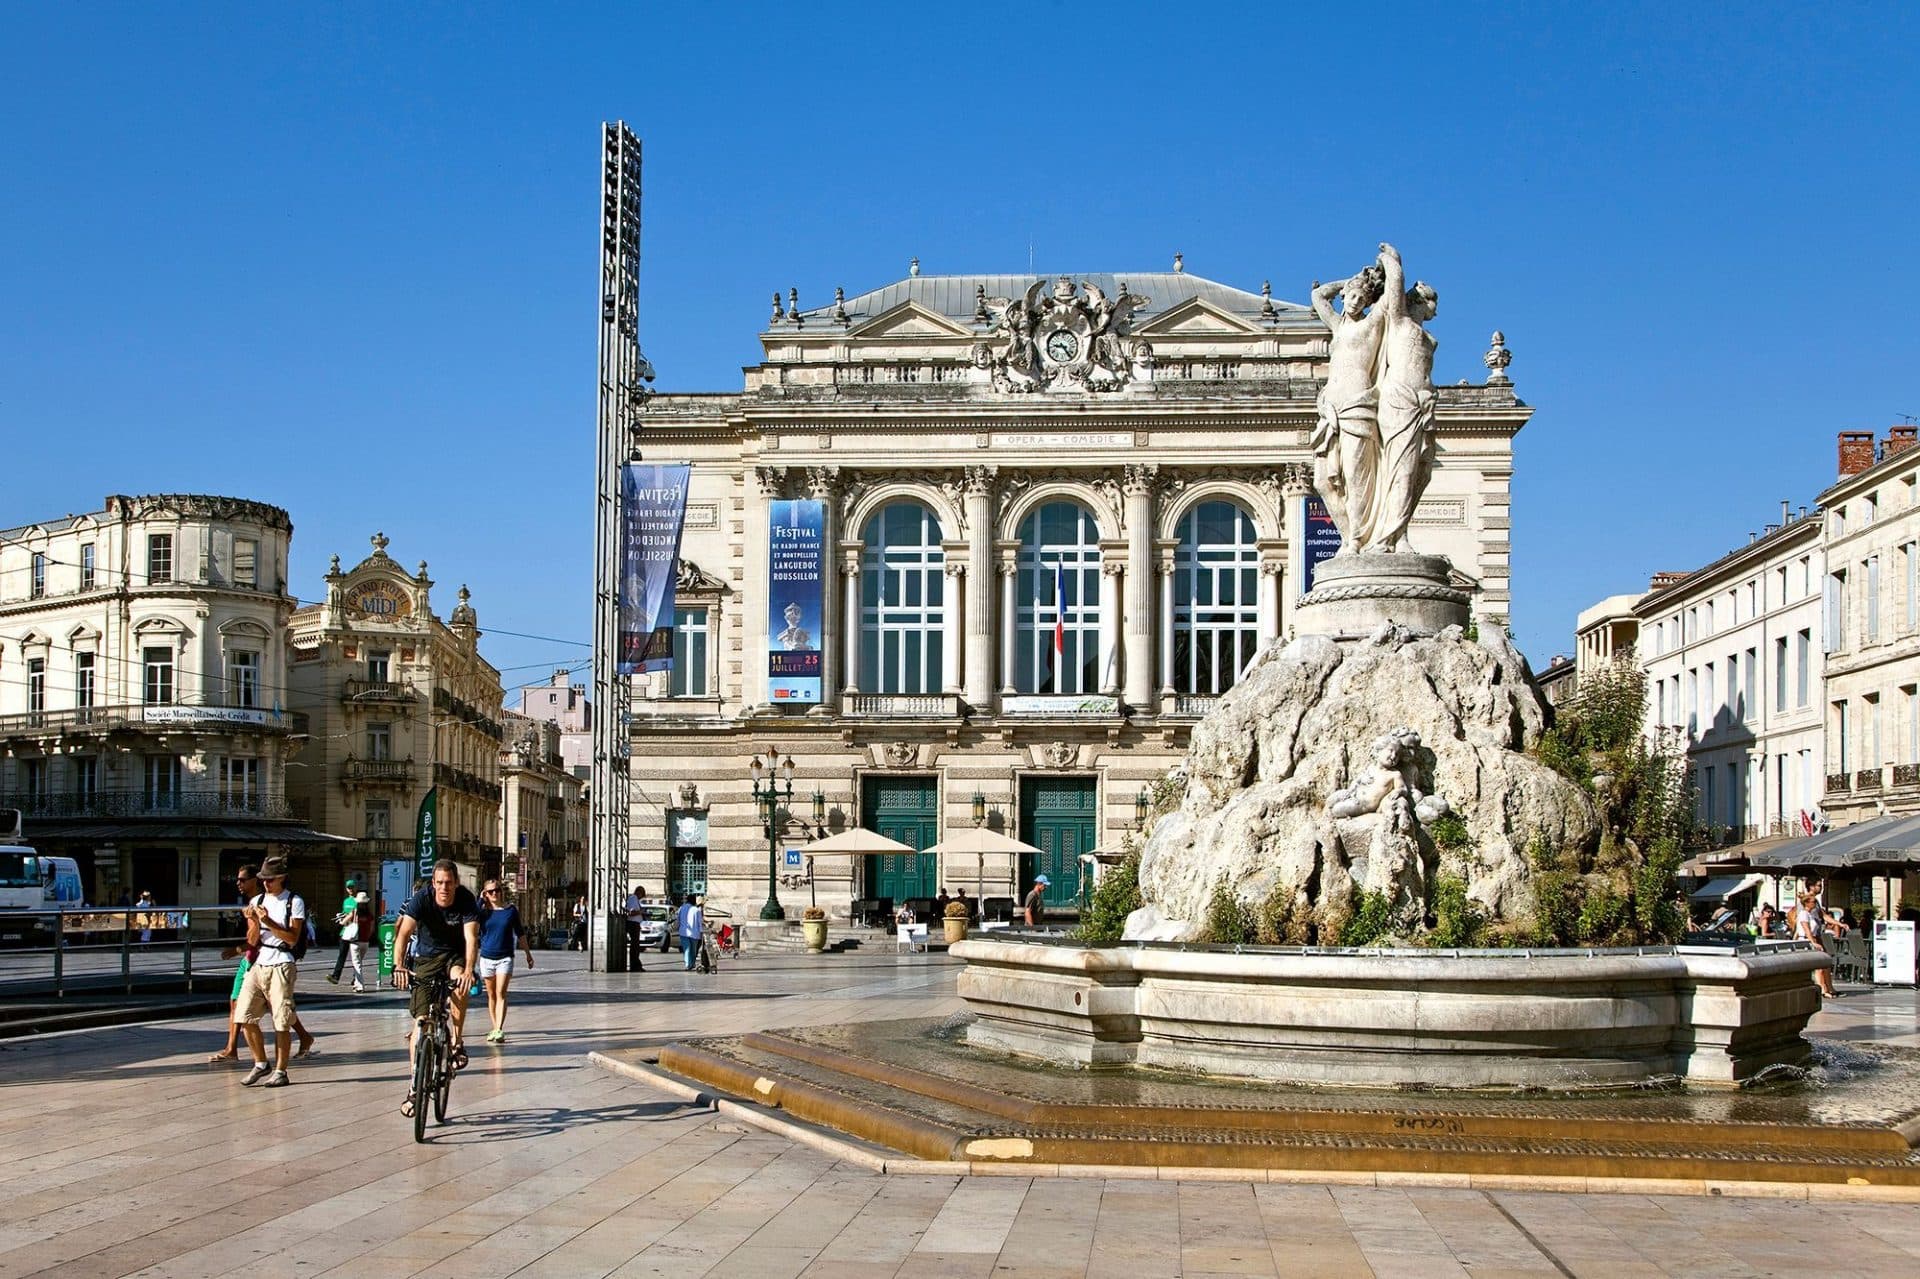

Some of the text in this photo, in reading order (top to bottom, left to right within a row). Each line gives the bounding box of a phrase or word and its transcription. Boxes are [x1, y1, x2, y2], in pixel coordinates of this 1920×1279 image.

[1007, 435, 1045, 444] OPERA
[1308, 502, 1318, 510] 11
[776, 525, 817, 540] FESTIVAL
[774, 562, 817, 570] LANGUEDOC
[773, 572, 818, 580] ROUSSILLON
[362, 597, 396, 614] MIDI
[771, 655, 818, 665] 11 25
[771, 664, 802, 672] JUILLET
